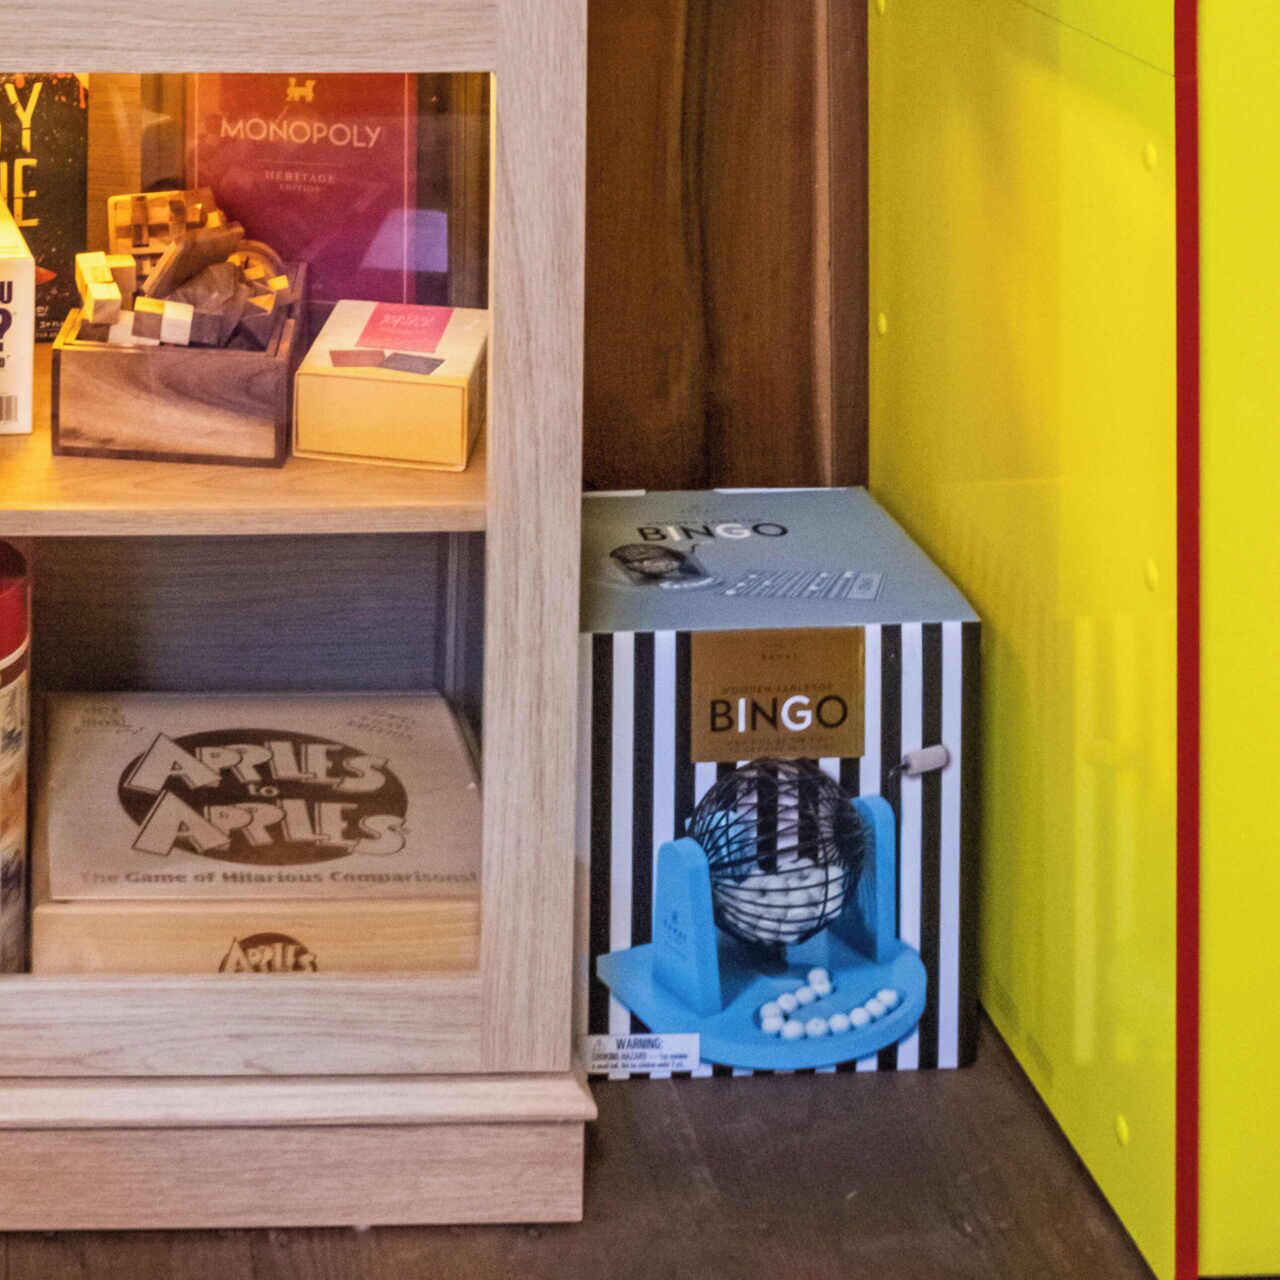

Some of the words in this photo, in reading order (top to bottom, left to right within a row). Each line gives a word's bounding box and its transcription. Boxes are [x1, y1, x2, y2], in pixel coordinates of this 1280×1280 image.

[220, 117, 382, 149] MONOPOLY
[264, 169, 336, 184] HERITAGE
[637, 522, 789, 542] BINGO
[710, 694, 848, 733] BINGO
[123, 731, 395, 794] APPLES
[245, 781, 281, 798] to
[131, 790, 410, 857] APPLES
[81, 872, 118, 884] The
[125, 871, 187, 884] Game
[194, 871, 215, 883] of
[222, 871, 323, 884] Hilarious
